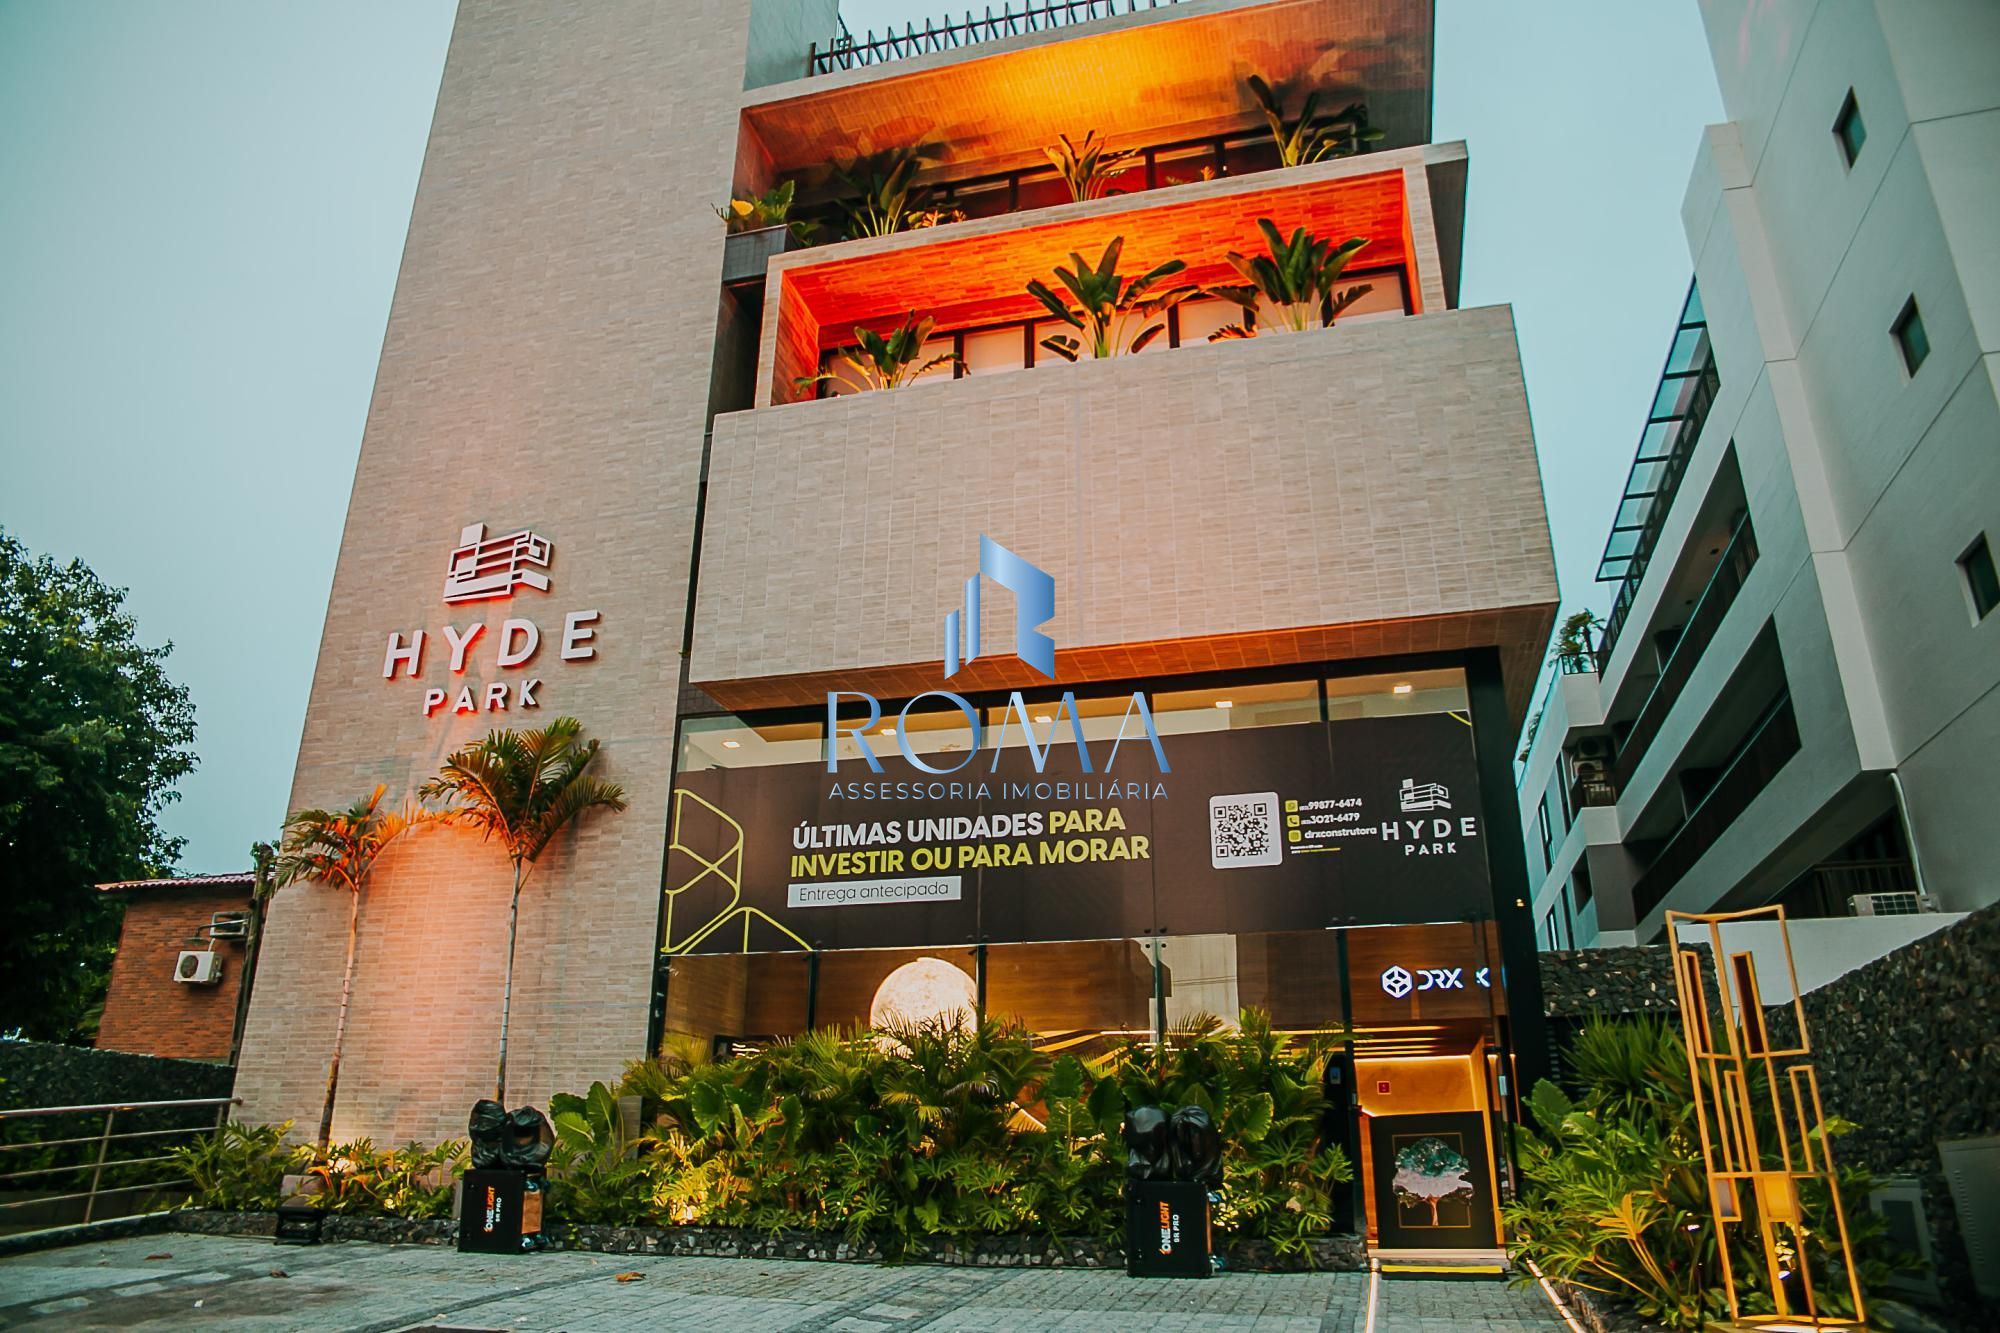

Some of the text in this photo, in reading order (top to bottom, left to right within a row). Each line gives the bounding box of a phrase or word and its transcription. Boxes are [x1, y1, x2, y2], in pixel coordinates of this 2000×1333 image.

[382, 609, 599, 679] HYDE
[422, 679, 542, 715] PARK
[793, 807, 1126, 849] ÚLTIMAS UNIDADES PARA
[1304, 827, 1377, 839] drxconstrutora
[1381, 816, 1477, 841] HYDE
[790, 835, 1150, 877] INVESTIR OU PARA MORAR
[1404, 842, 1456, 856] PARK
[799, 881, 949, 903] Entrega antecipada
[1415, 967, 1464, 991] DRX
[1160, 1201, 1171, 1252] ONELIGHT
